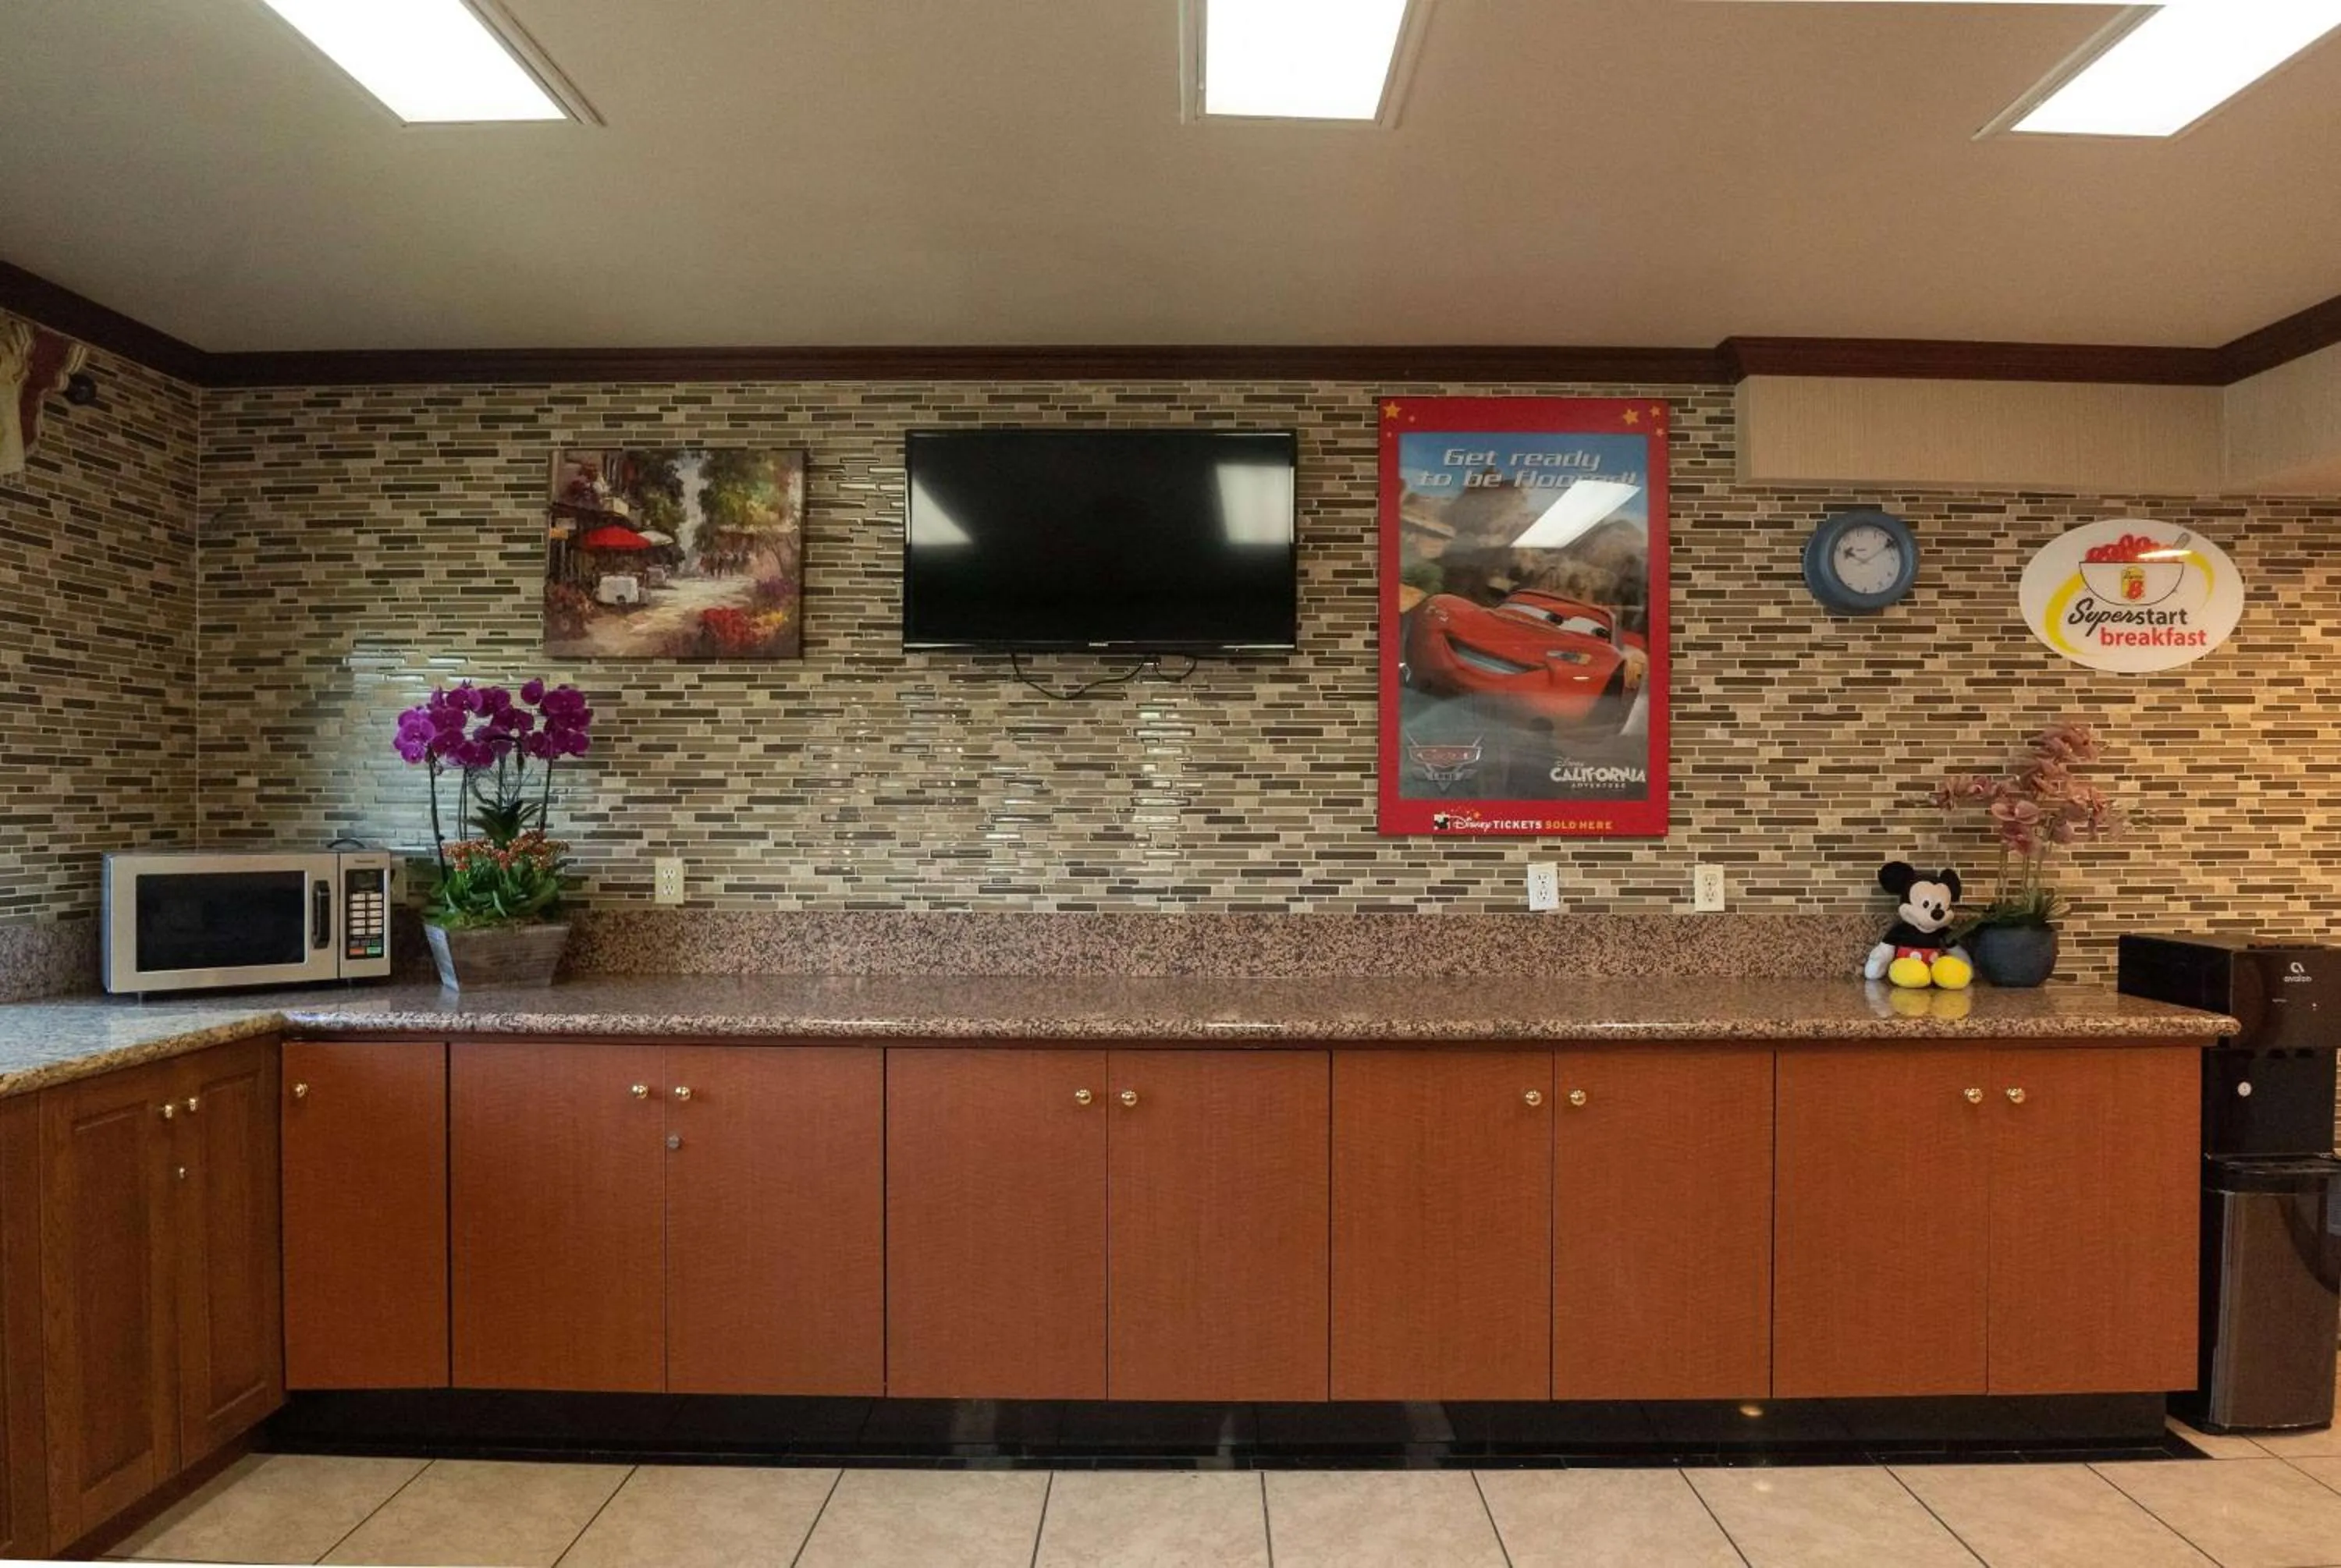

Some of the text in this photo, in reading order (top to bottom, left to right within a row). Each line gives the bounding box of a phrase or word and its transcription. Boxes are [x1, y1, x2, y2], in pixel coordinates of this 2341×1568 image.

[1444, 449, 1600, 471] Get ready
[1419, 471, 1452, 487] to
[1464, 470, 1502, 488] be
[2067, 598, 2187, 637] Superstart
[2100, 626, 2207, 646] breakfast
[1550, 767, 1647, 782] CALIFORNIA
[1493, 820, 1543, 829] TICKETS
[1544, 820, 1575, 829] SOLD
[1579, 820, 1613, 829] HERE
